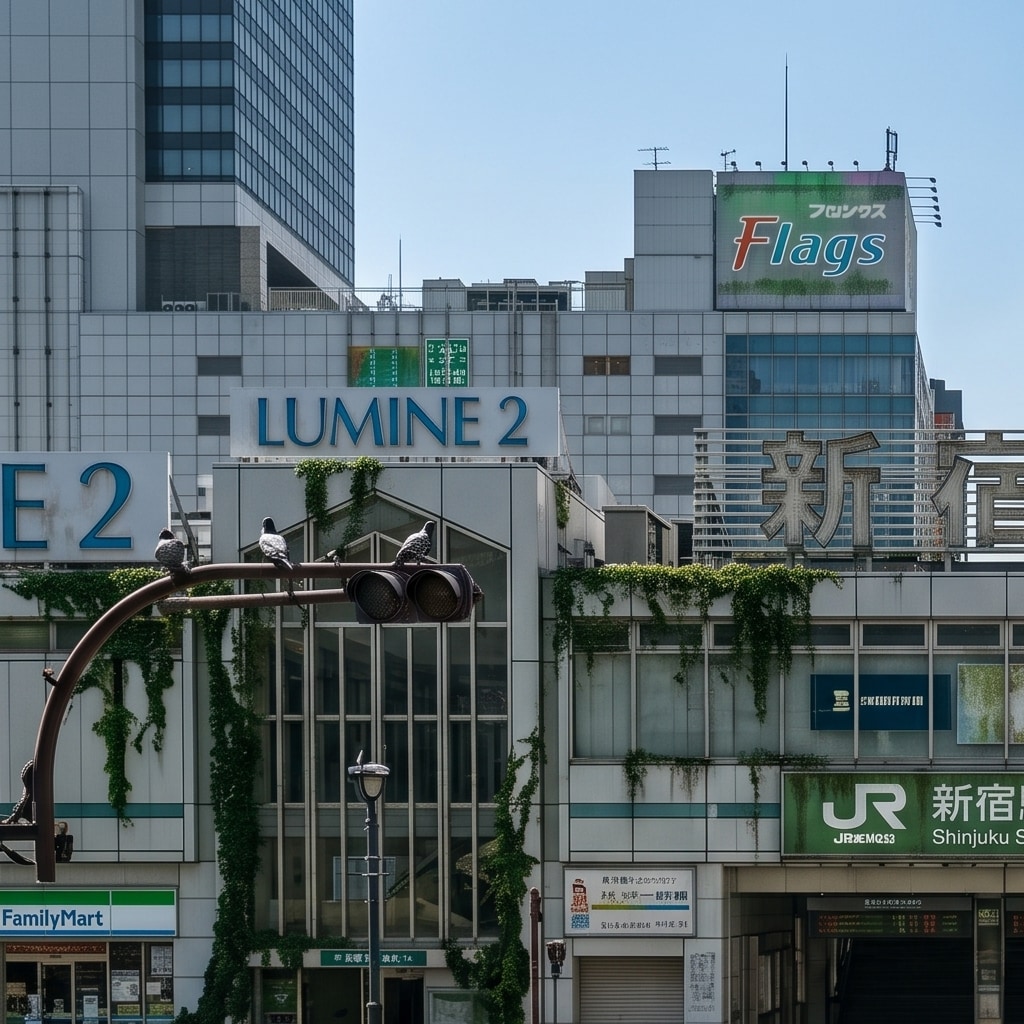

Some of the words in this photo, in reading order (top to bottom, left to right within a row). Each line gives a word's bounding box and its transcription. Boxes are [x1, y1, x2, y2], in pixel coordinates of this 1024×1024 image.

[731, 215, 887, 277] Flags
[257, 396, 481, 447] LUMINE
[498, 395, 530, 446] 2
[79, 462, 132, 549] 2
[822, 783, 907, 830] JR
[932, 828, 1010, 848] Shinjuku
[2, 908, 104, 930] FamilyMart
